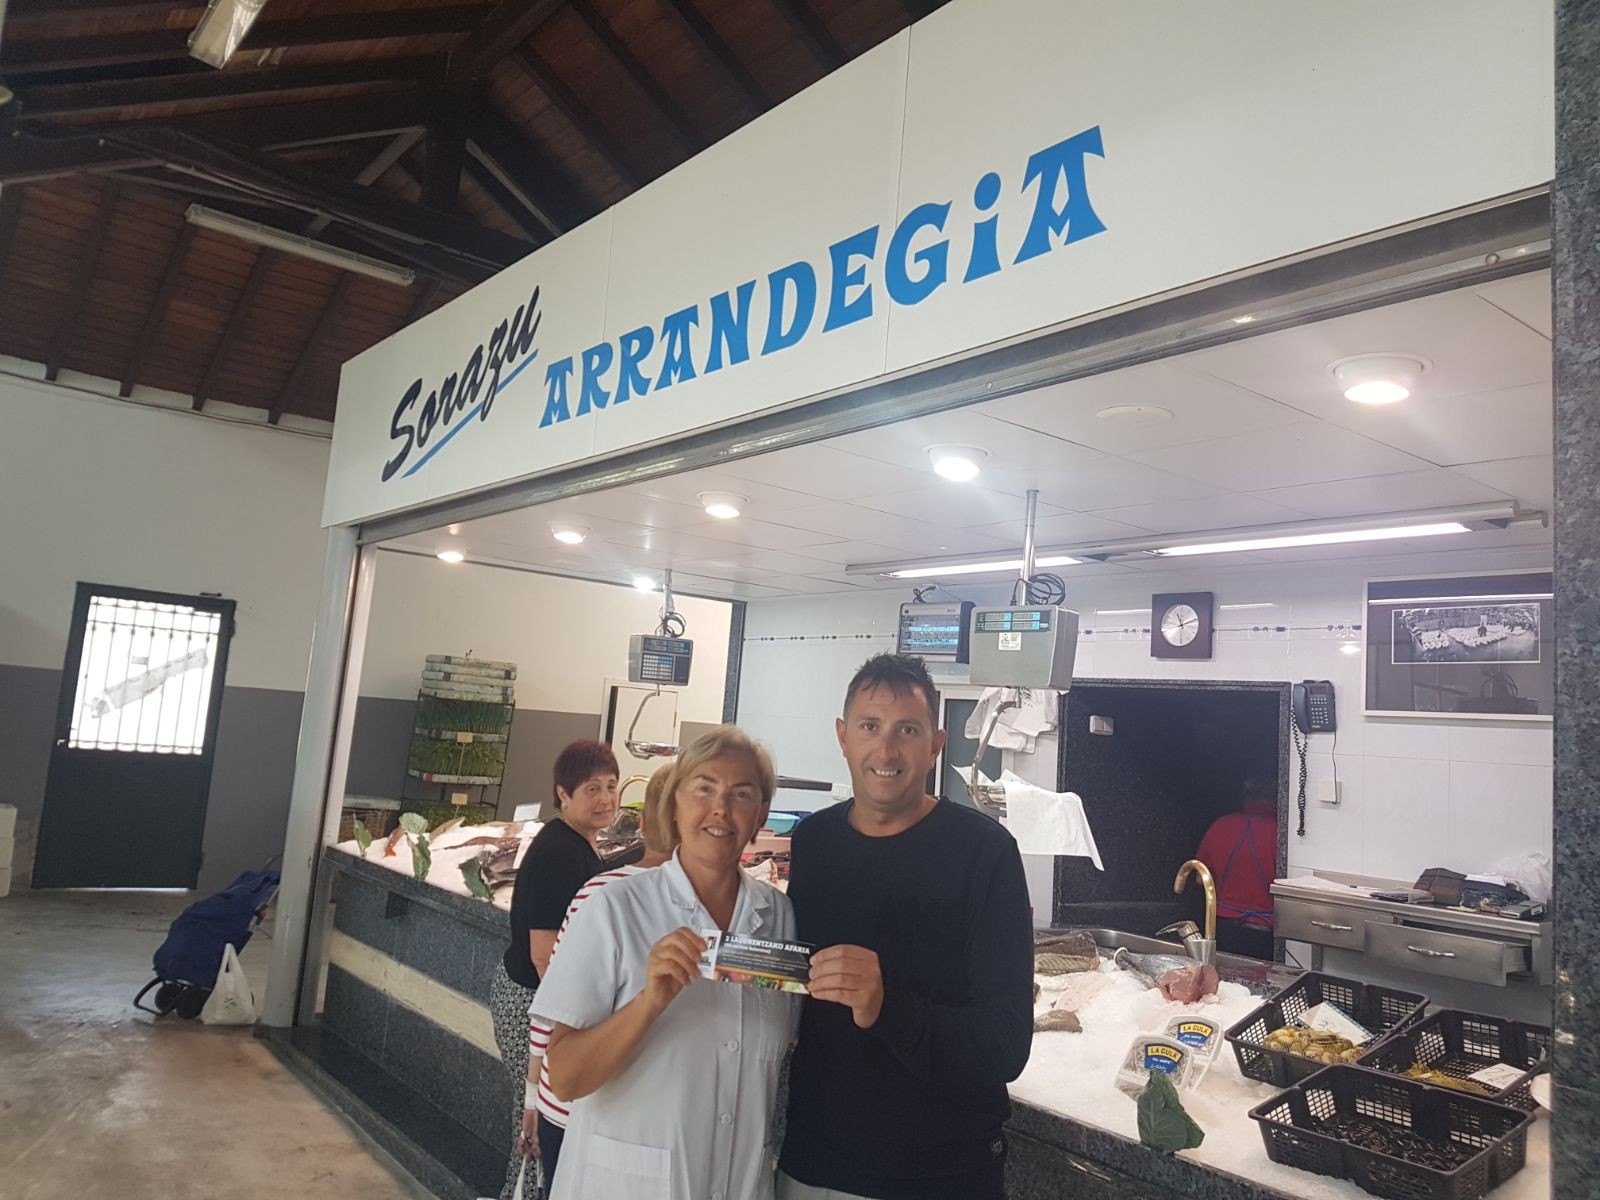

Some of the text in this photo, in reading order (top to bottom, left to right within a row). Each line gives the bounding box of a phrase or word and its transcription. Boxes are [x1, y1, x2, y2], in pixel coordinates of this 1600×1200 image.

[381, 285, 542, 482] Sorazu
[730, 936, 784, 950] LAGUNENTZAKO
[784, 943, 810, 955] AFARIA
